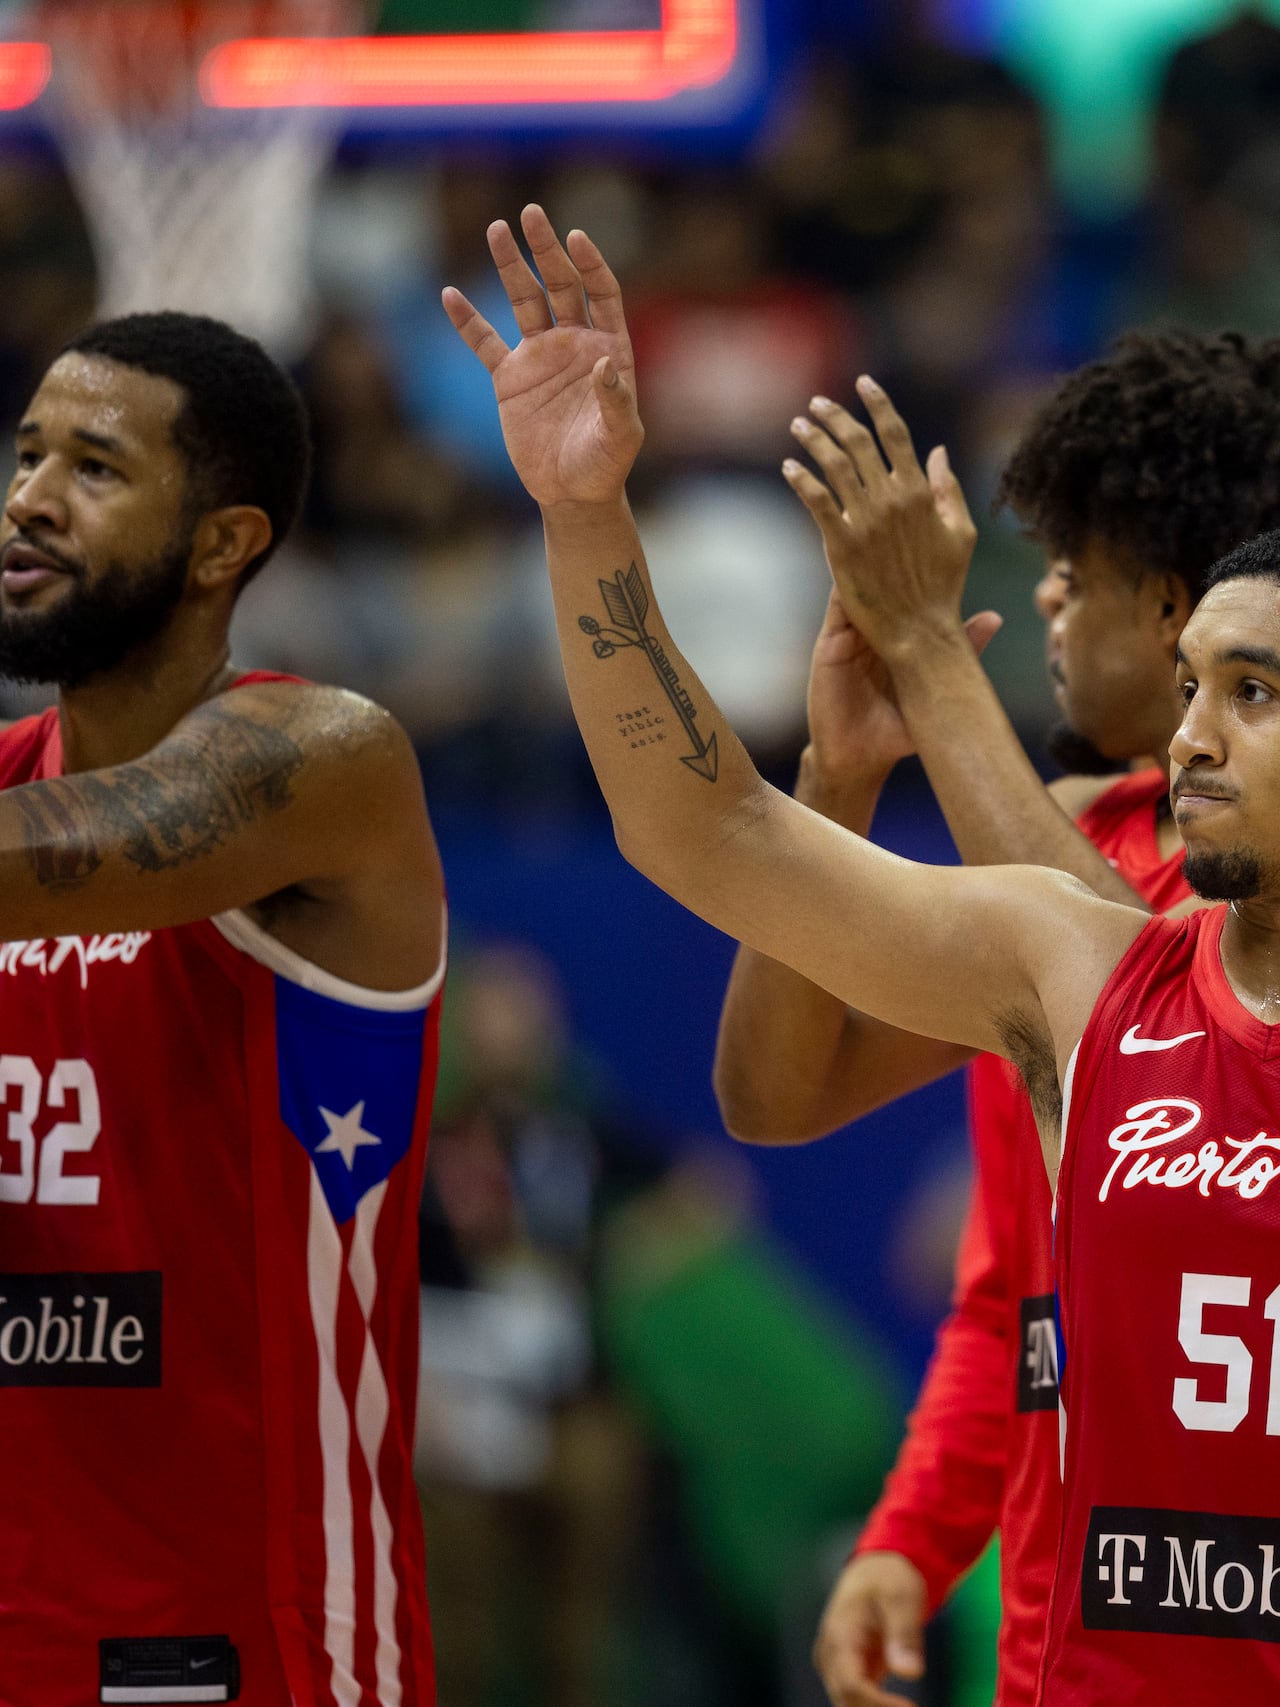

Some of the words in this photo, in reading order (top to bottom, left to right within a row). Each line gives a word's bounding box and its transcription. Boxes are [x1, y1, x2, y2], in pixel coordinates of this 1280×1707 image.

[0, 1055, 101, 1205] 32
[0, 1295, 145, 1366] obile
[1099, 1533, 1146, 1605] T
